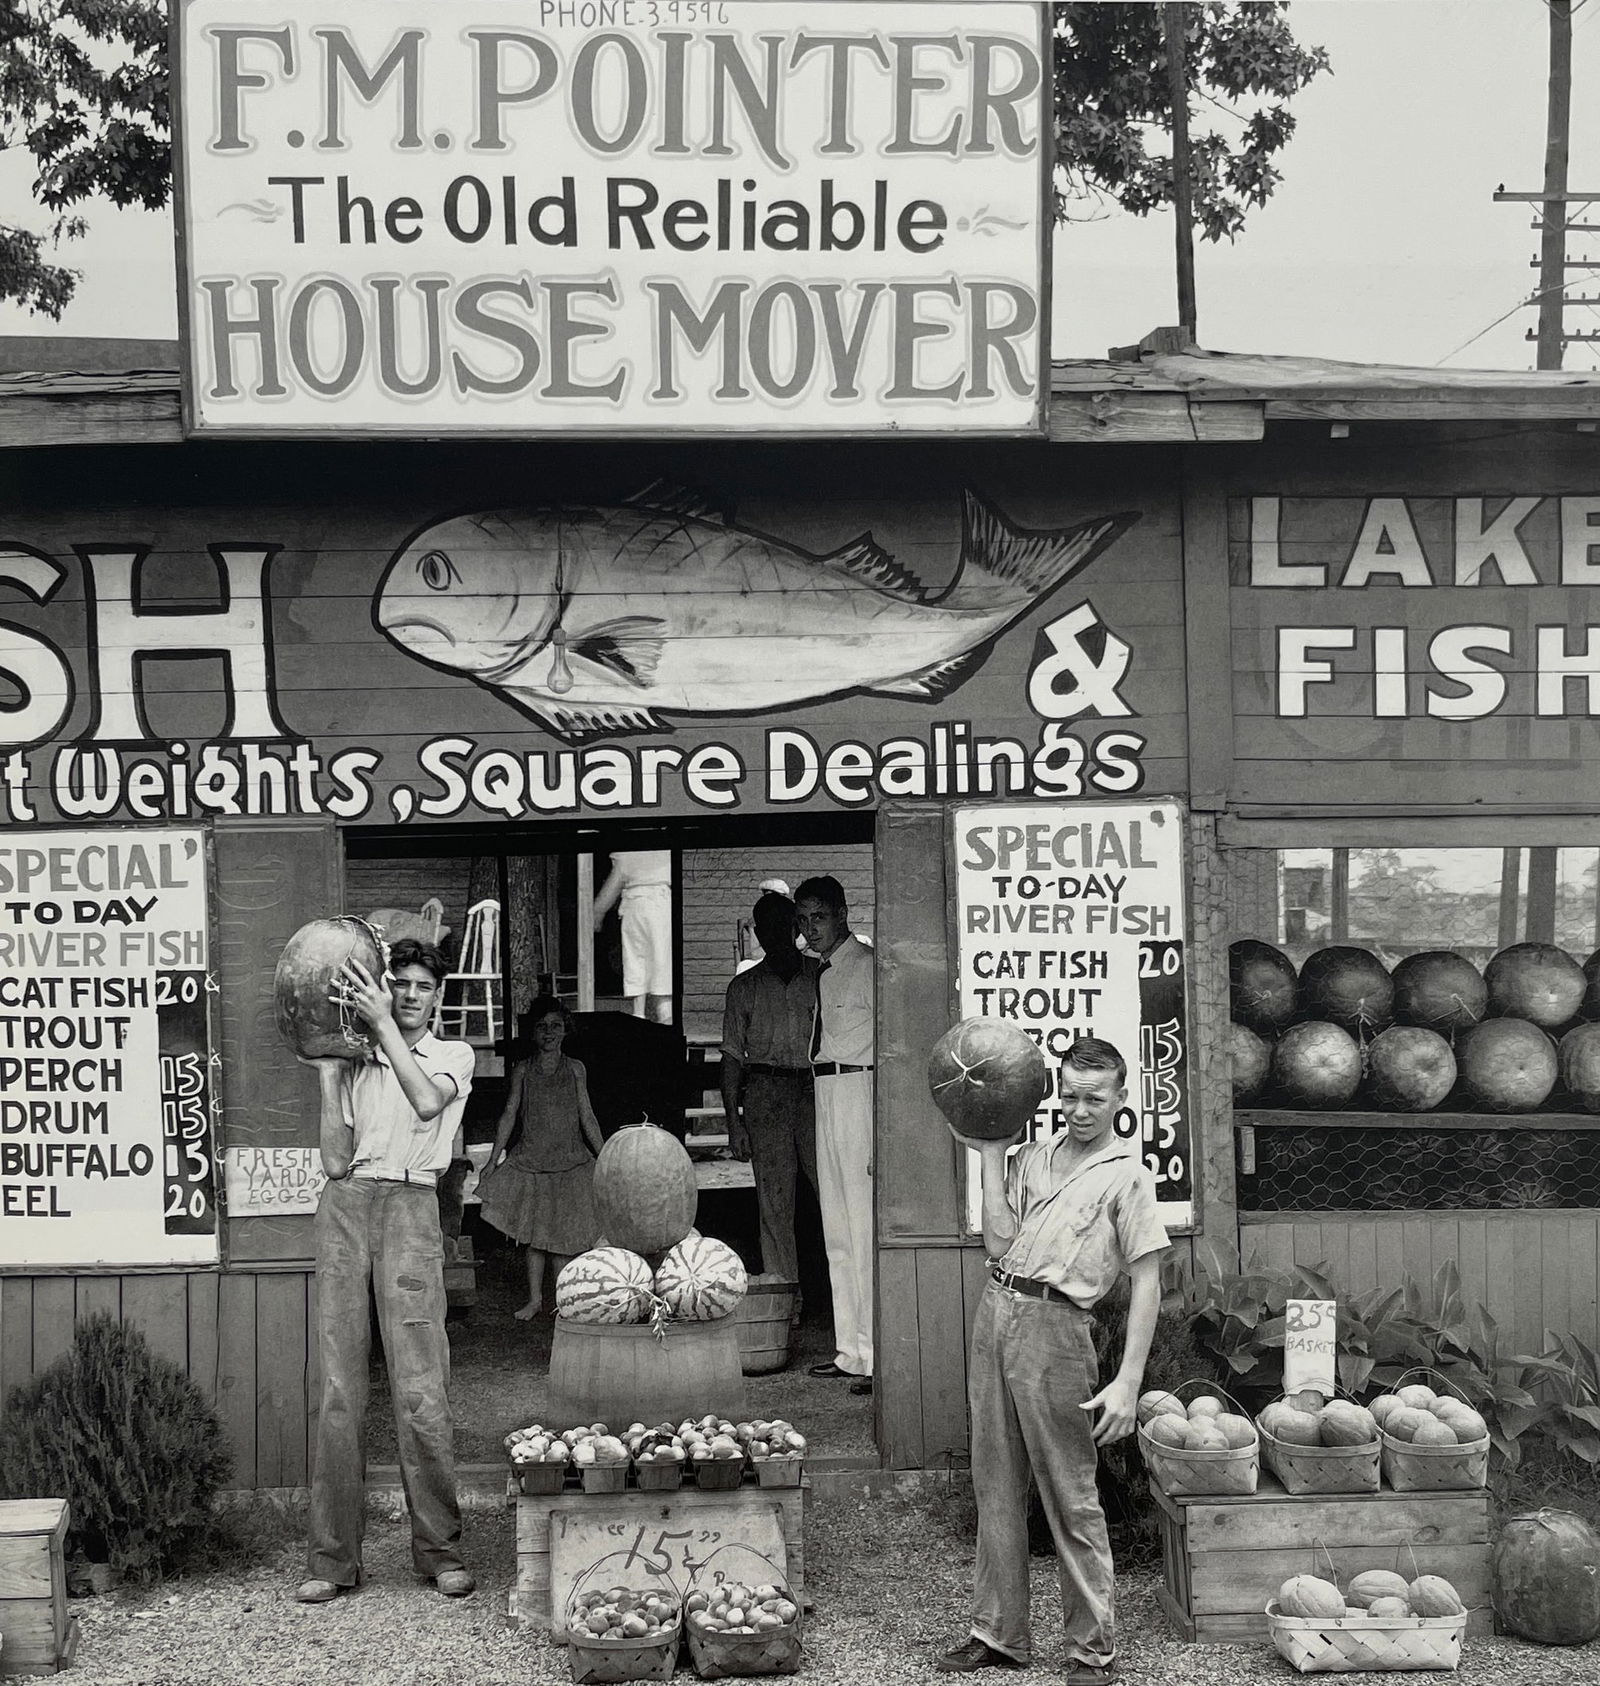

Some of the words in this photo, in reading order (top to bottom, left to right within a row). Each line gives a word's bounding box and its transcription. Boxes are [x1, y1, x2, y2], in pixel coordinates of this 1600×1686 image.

[207, 26, 451, 151] F.M.
[468, 31, 1040, 170] POINTER
[268, 176, 424, 245] The
[443, 175, 578, 248] Old
[607, 178, 948, 253] Reliable
[202, 277, 626, 402] HOUSE
[647, 279, 1038, 401] MOVER
[1277, 623, 1600, 721] FISH
[54, 740, 382, 820] Weights
[768, 722, 1147, 799] Dealings
[5, 902, 63, 925] TO
[74, 896, 158, 927] DAY
[966, 904, 1075, 935] RIVER
[1086, 904, 1170, 936] FISH
[0, 930, 107, 968] RIVER
[120, 929, 204, 966] FISH
[972, 951, 1032, 979] CAT
[1039, 950, 1108, 979] FISH
[1139, 946, 1181, 979] 20
[0, 977, 64, 1009] CAT
[71, 976, 149, 1009] FISH
[973, 988, 1102, 1020] TROUT
[0, 1016, 131, 1049] TROUT
[1140, 1017, 1182, 1072] 15
[1, 1057, 123, 1093] PERCH
[1142, 1068, 1182, 1114] 15
[2, 1100, 109, 1135] DRUM
[1142, 1111, 1182, 1149] 15
[2, 1143, 154, 1180] BUFFALO
[237, 1149, 312, 1169] FRESH
[1144, 1153, 1184, 1184] 20
[2, 1185, 72, 1218] EEL
[249, 1188, 312, 1204] EGGS
